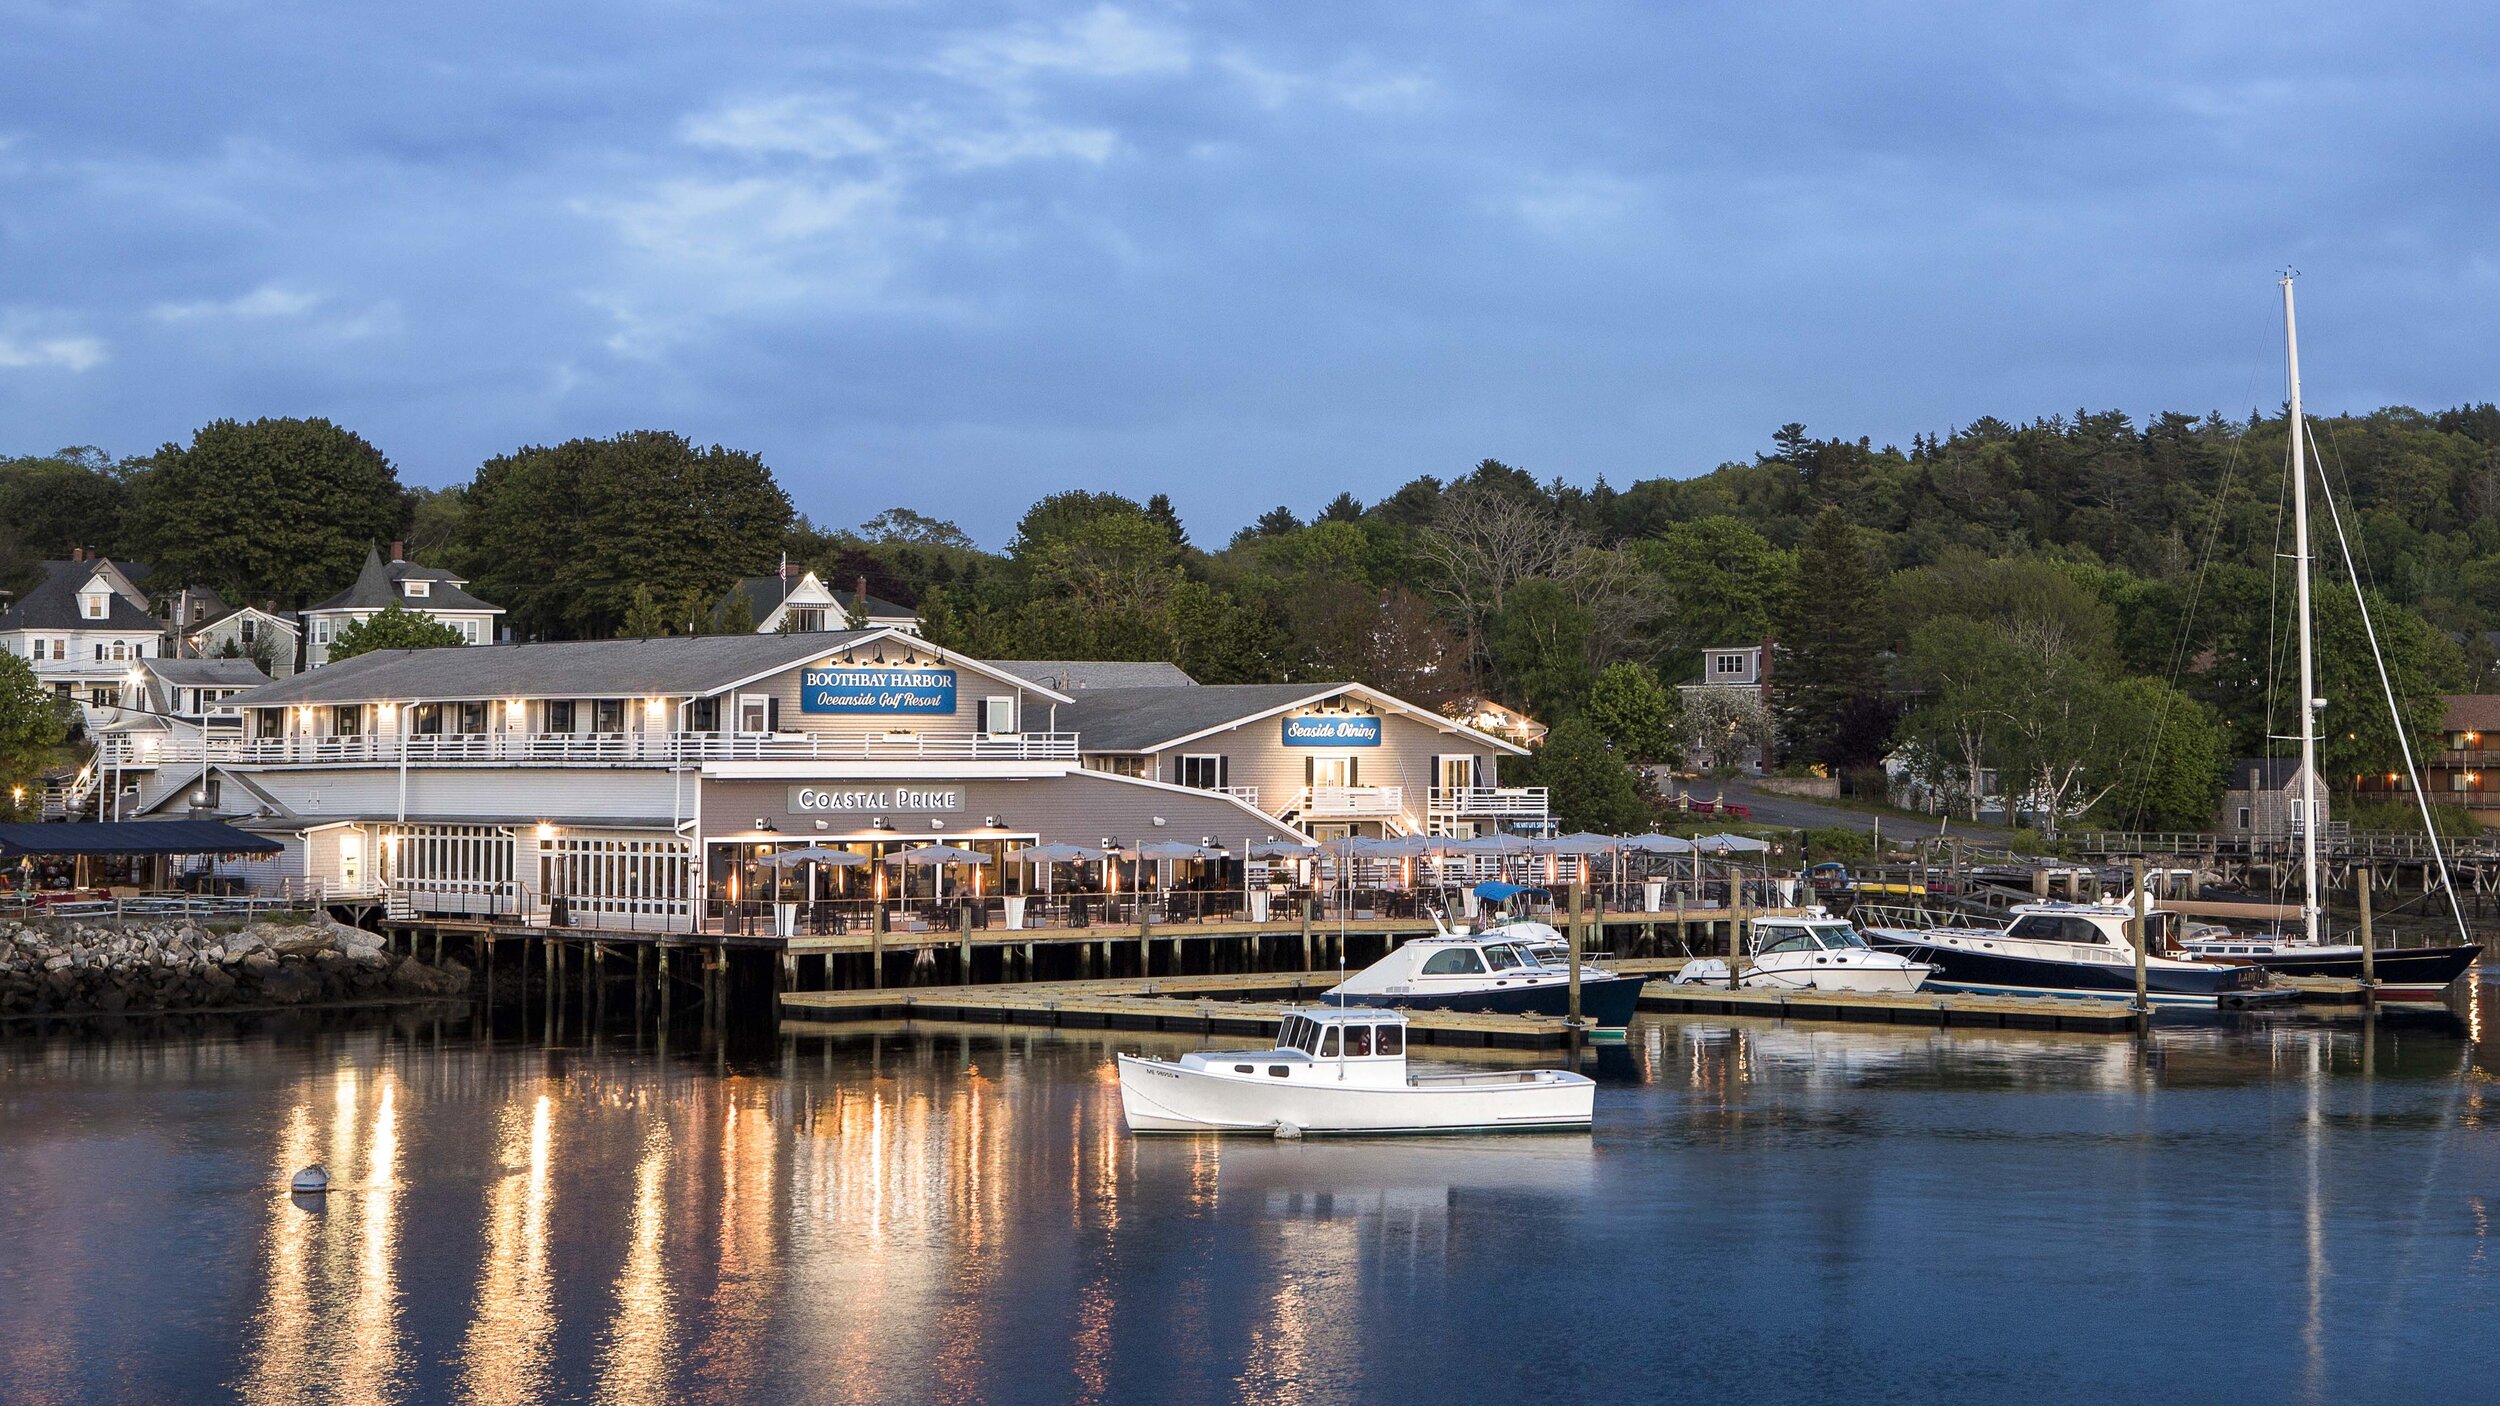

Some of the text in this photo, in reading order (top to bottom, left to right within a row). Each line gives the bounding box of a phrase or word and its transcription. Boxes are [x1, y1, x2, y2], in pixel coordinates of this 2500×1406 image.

[806, 673, 953, 688] BOOTHBAY HARBOR
[817, 691, 942, 709] Oceanside Golf Resort
[1287, 722, 1376, 740] Seaside Dining
[798, 788, 956, 809] COASTAL PRIME
